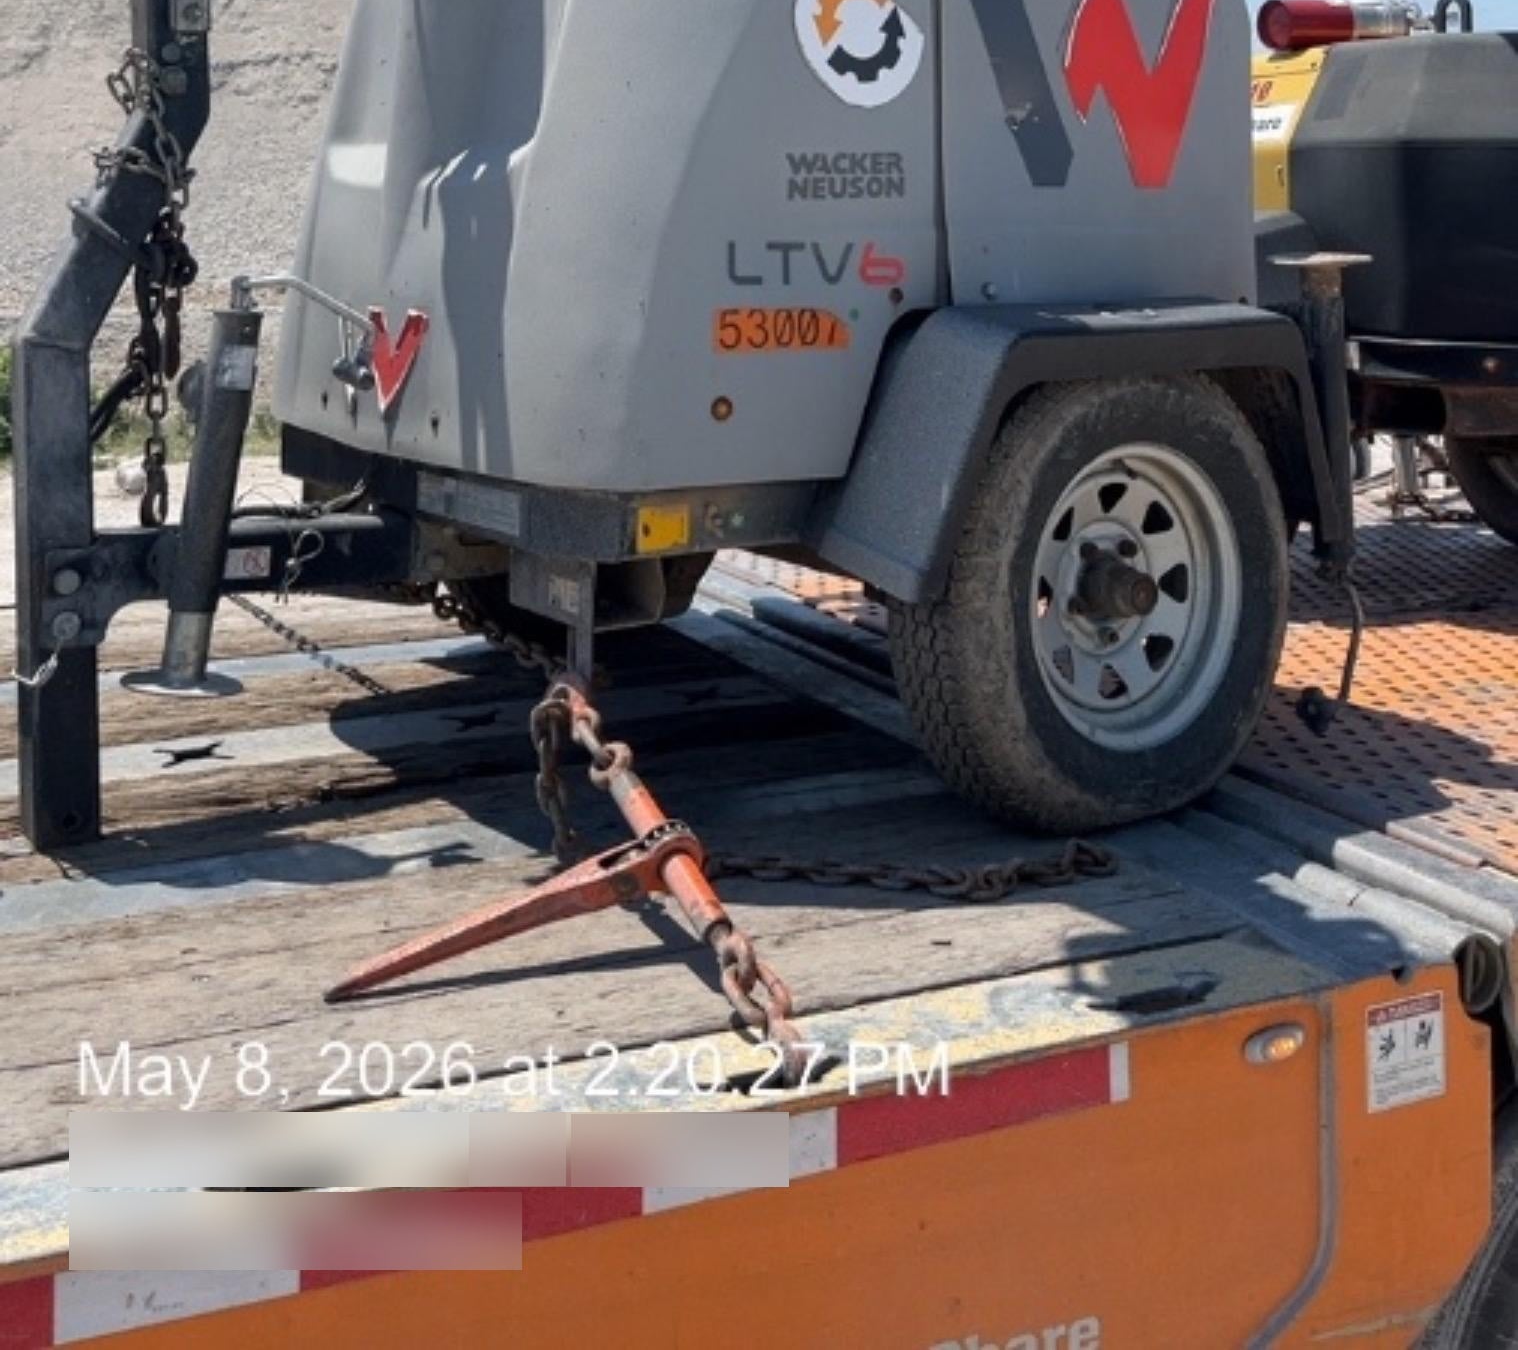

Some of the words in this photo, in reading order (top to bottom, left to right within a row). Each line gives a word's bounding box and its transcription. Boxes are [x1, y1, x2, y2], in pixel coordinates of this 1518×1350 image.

[786, 152, 905, 176] WACKER
[787, 176, 905, 201] NEUSON
[728, 240, 906, 288] LTV6
